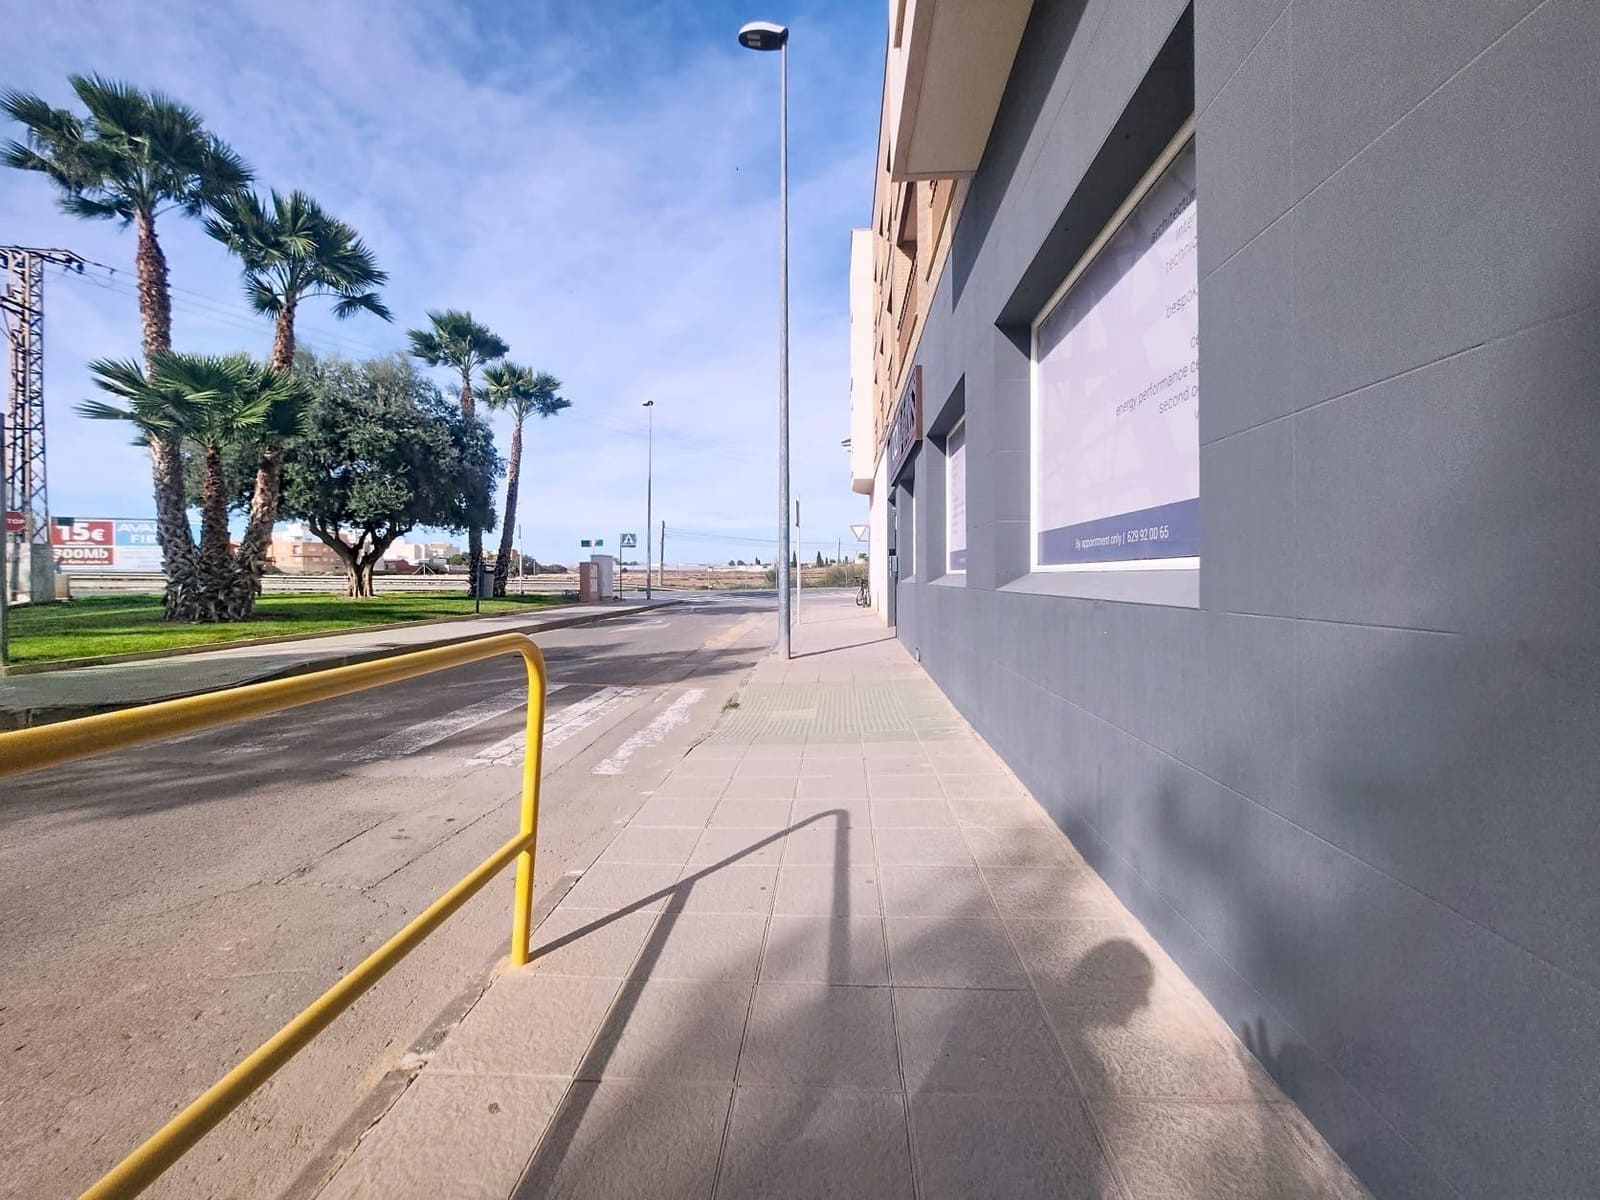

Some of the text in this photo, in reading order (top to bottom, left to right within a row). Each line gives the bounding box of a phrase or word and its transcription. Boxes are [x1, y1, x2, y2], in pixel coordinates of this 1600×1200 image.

[1116, 396, 1137, 416] energy
[1138, 364, 1188, 407] performance
[1160, 385, 1189, 413] second
[55, 523, 105, 541] 15€
[1081, 536, 1109, 549] appointment
[1110, 533, 1122, 547] only
[1127, 530, 1139, 542] 629
[1140, 528, 1148, 541] 92
[1149, 526, 1159, 540] 00
[1159, 525, 1169, 538] 65
